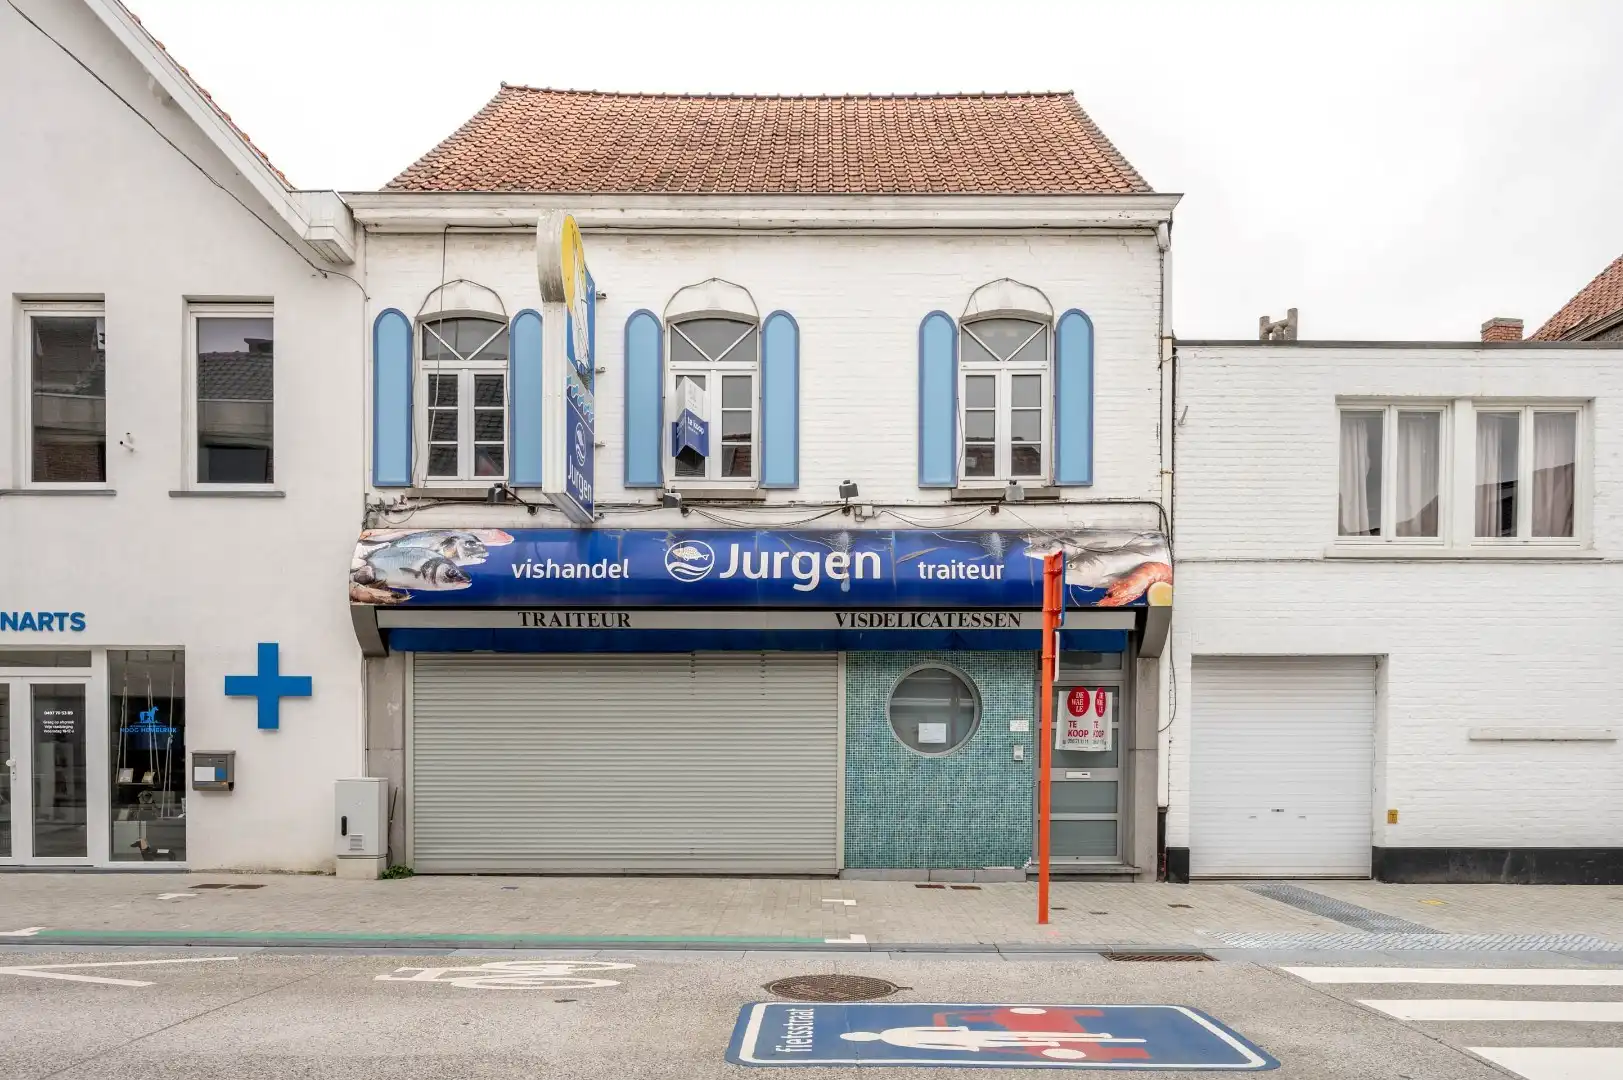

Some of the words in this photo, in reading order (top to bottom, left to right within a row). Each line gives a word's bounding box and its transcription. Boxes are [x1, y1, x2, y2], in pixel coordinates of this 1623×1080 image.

[568, 454, 592, 504] Jurgen
[511, 558, 629, 579] vishandel
[719, 543, 881, 592] Jurgen
[918, 560, 1005, 580] traiteur
[0, 611, 86, 632] NARTS
[517, 612, 632, 628] TRAITEUR
[834, 613, 1022, 629] VISDELICATESSEN
[1067, 729, 1089, 738] KOOP
[1068, 720, 1078, 729] TE
[775, 1008, 814, 1053] fietsstraat
